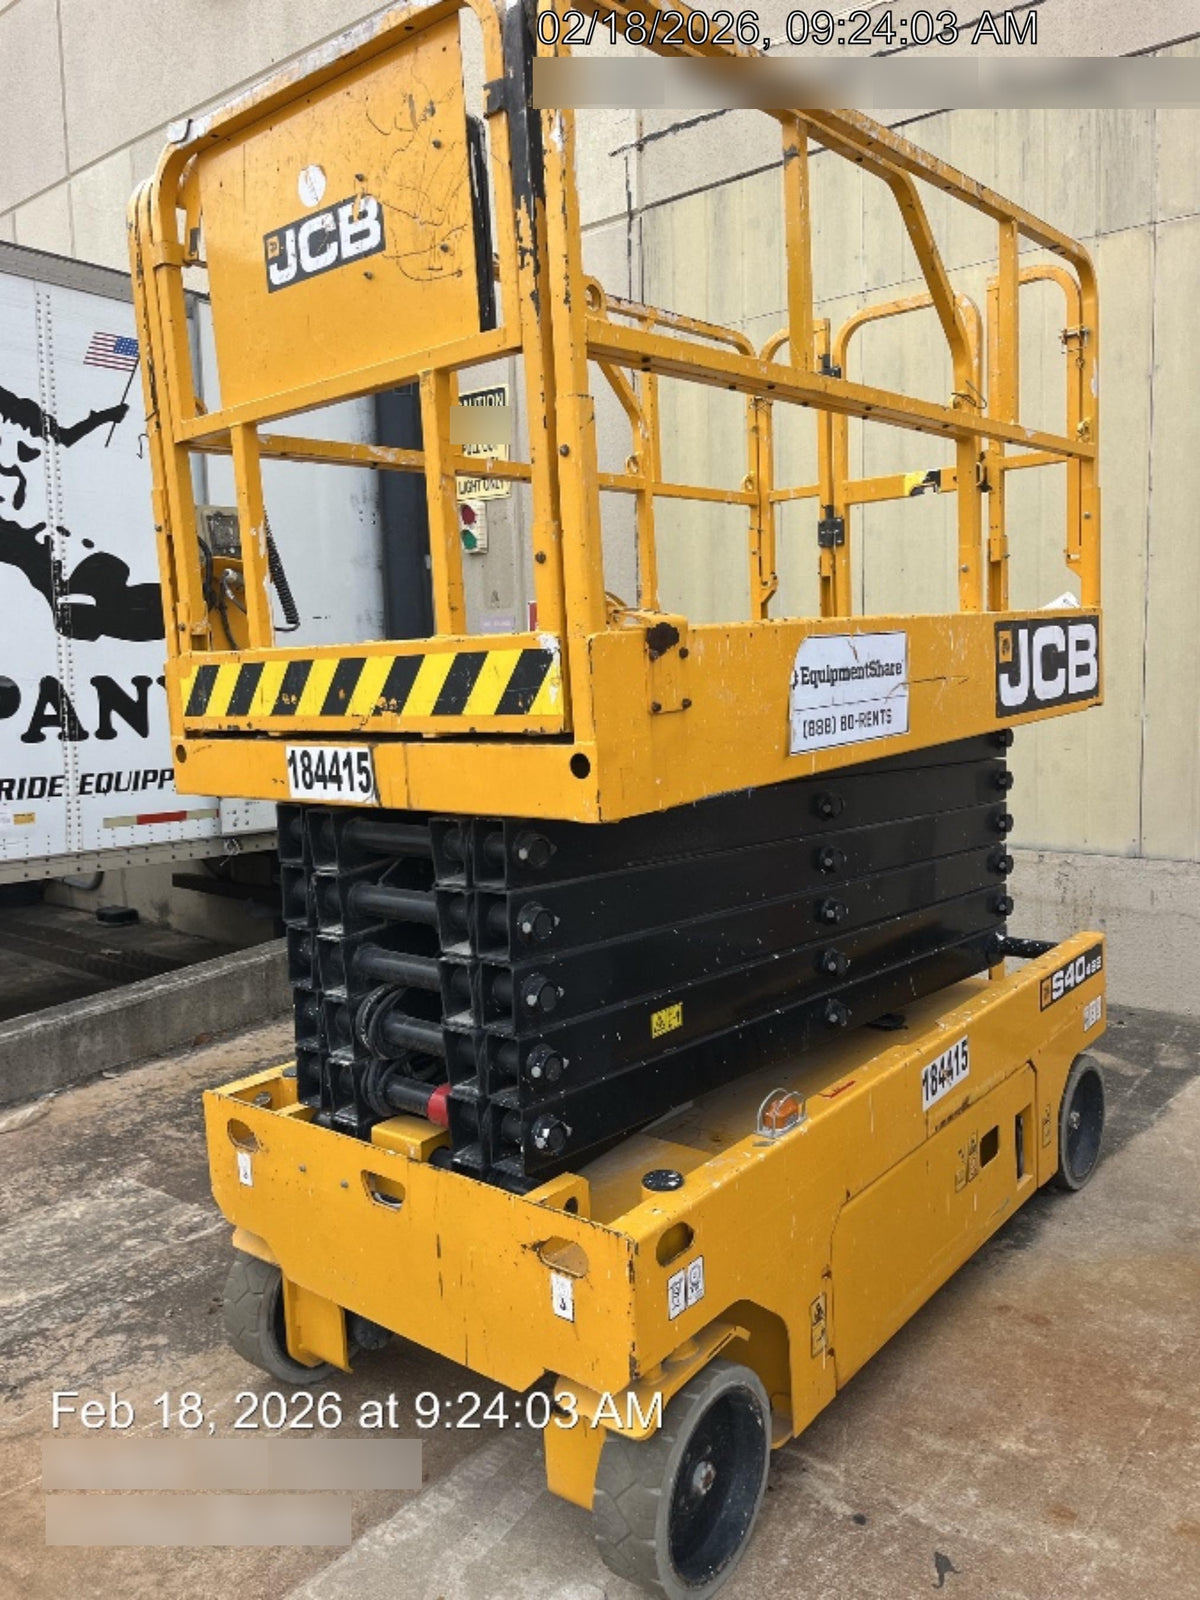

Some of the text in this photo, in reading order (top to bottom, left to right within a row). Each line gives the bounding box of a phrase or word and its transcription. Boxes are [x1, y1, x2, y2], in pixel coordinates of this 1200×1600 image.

[269, 194, 381, 285] JCB
[800, 659, 903, 689] EquipmentShare
[999, 624, 1098, 706] JCB
[803, 708, 893, 740] (888) 80-RENTS
[287, 750, 371, 793] 184415
[922, 1039, 968, 1102] 184415
